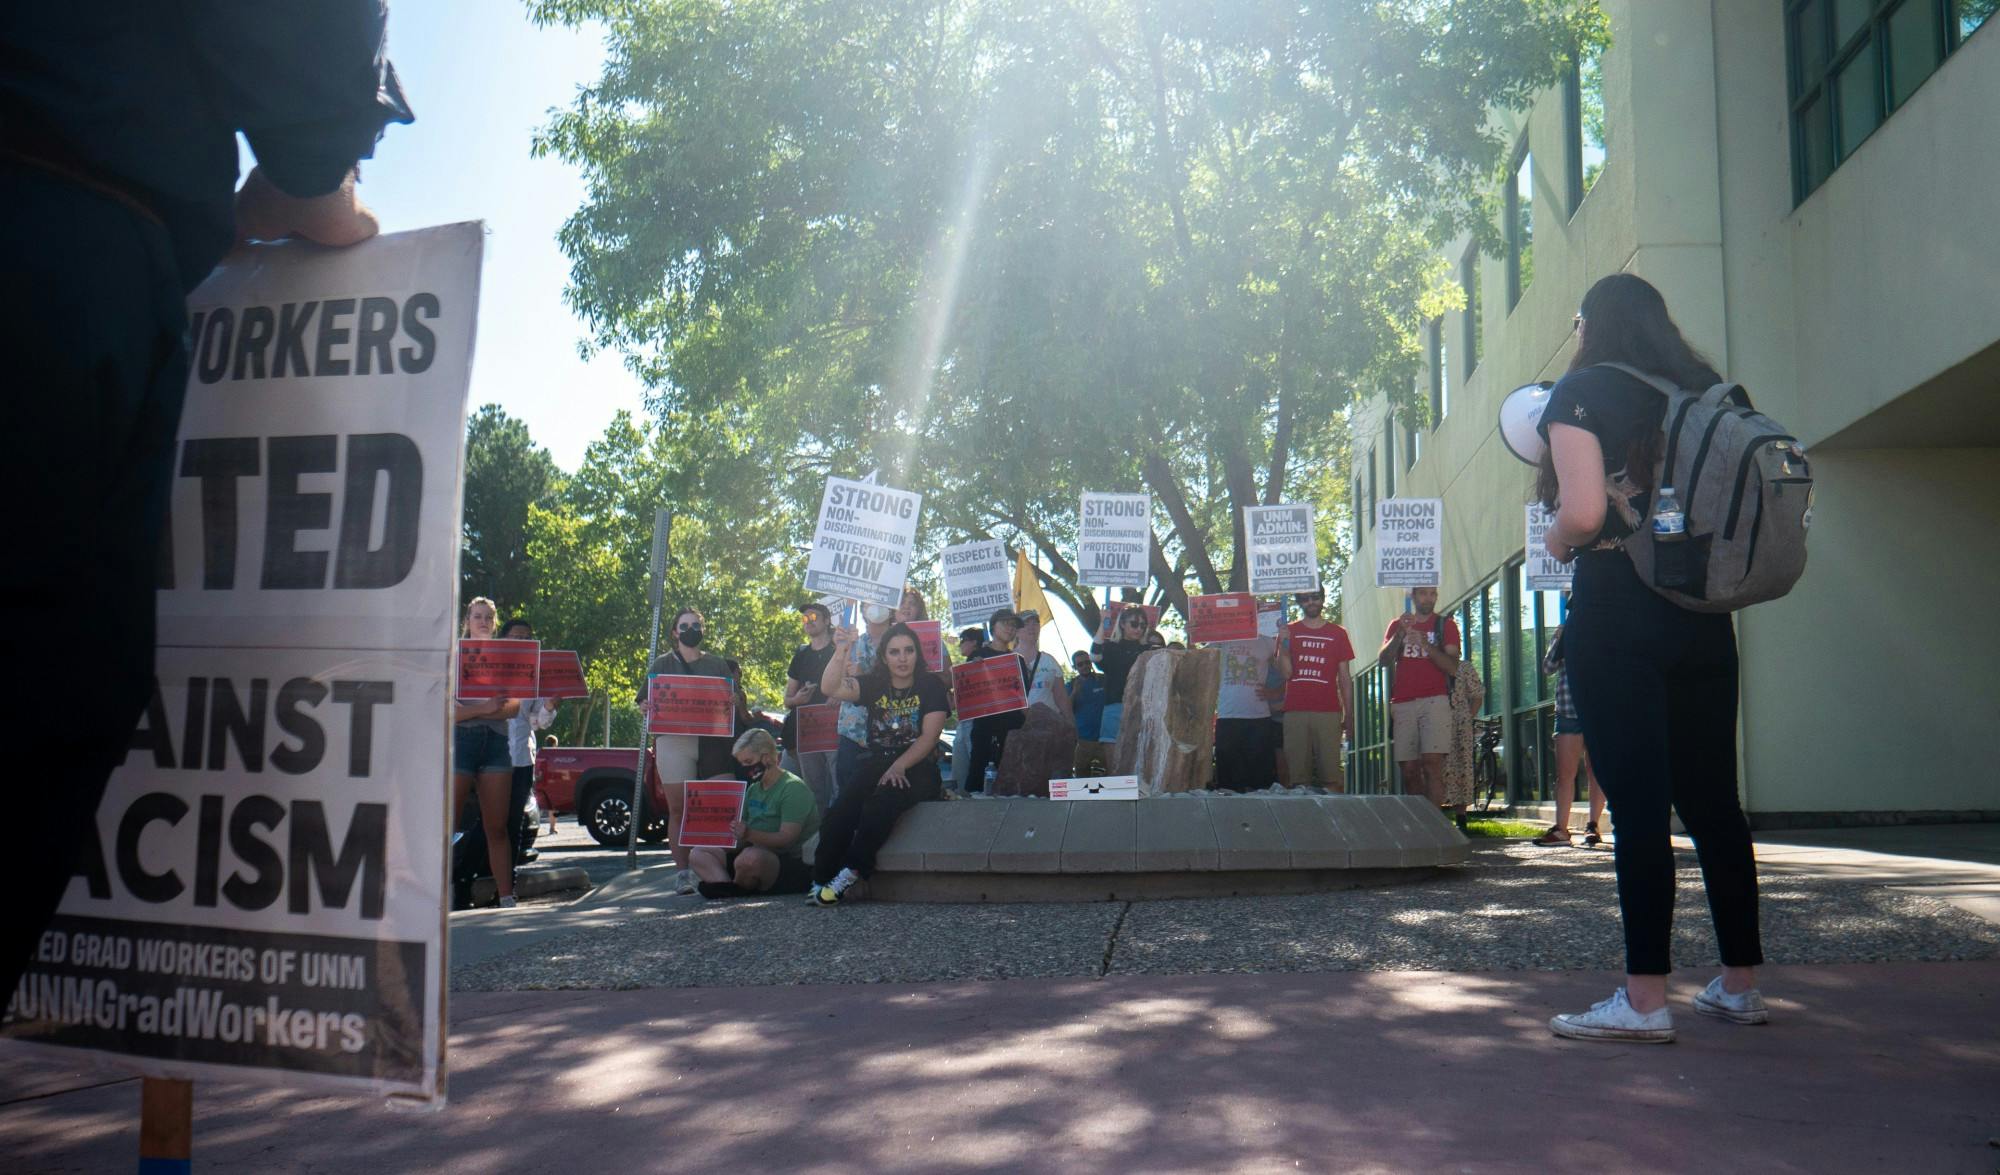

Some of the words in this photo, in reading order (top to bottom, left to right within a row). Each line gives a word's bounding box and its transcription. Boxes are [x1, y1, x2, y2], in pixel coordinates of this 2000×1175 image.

[190, 292, 440, 384] ORKERS
[830, 485, 913, 519] STRONG
[1085, 500, 1144, 517] STRONG
[827, 506, 860, 522] NON-
[1263, 510, 1293, 522] UNM
[1382, 503, 1435, 517] UNION
[1084, 517, 1109, 528] NON-
[1257, 521, 1305, 534] ADMIN:
[1382, 519, 1434, 530] STRONG
[824, 520, 906, 546] DISCRIMINATION
[1084, 528, 1144, 538] DISCRIMINATION
[1254, 536, 1267, 545] NO
[1270, 535, 1307, 545] BIGOTRY
[1397, 532, 1419, 542] FOR
[820, 536, 903, 564] PROTECTIONS
[1084, 542, 1143, 552] PROTECTIONS
[1382, 547, 1434, 556] WOMEN'S
[945, 547, 991, 565] RESPECT
[994, 546, 1001, 558] &
[1095, 553, 1131, 569] NOW
[1256, 554, 1271, 566] IN
[1276, 552, 1308, 565] OUR
[831, 553, 884, 581] NOW
[948, 561, 1004, 577] ACCOMMODATE
[1381, 558, 1434, 570] RIGHTS
[1255, 567, 1311, 577] UNIVERSITY.
[950, 584, 988, 598] WORKERS
[988, 582, 1008, 592] WITH
[952, 593, 1009, 611] DISABILITIES
[1299, 655, 1325, 664] POWER
[32, 931, 66, 963] ED
[72, 932, 131, 970] GRAD
[137, 942, 255, 981] WORKERS
[261, 952, 295, 985] OF
[302, 954, 366, 990] UNM
